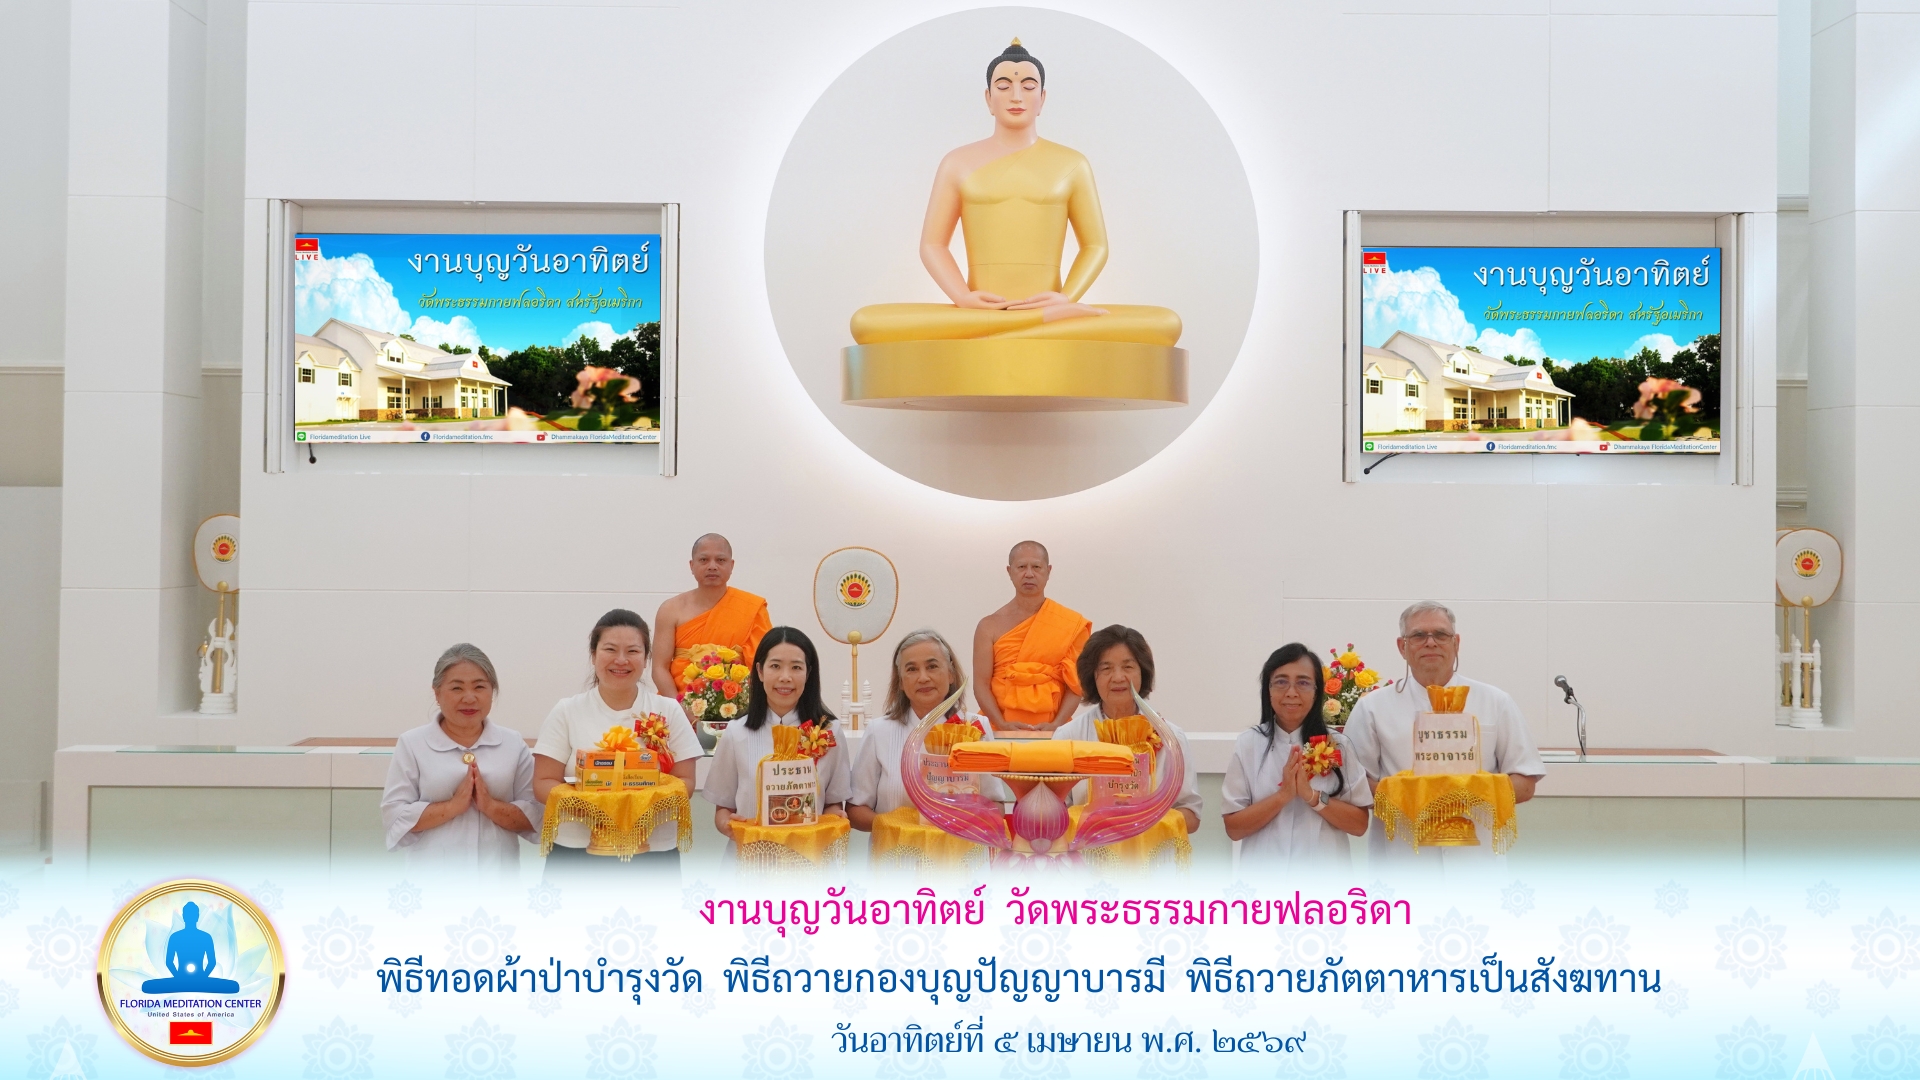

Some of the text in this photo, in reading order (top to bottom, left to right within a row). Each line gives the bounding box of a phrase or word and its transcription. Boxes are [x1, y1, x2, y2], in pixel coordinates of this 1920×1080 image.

[408, 241, 650, 282] งานบุญวันอาทิตย์
[1473, 255, 1711, 295] งานบุญวันอาทิตย์
[418, 287, 643, 313] วัดพระธรรมกายฟลอริดา สหรัฐอเมริกา
[1483, 300, 1704, 326] วัดพระธรรมกายฟลอริดา สหรัฐอเมริกา
[309, 433, 371, 441] Floridameditation Live
[551, 433, 588, 442] Dhammakaya
[1377, 443, 1438, 451] Floridameditation Live
[1613, 443, 1650, 452] Dhammakaya
[1417, 729, 1468, 744] บูชาธรรม
[1415, 746, 1475, 762] พระอาจารย์
[772, 763, 812, 776] ประธาน
[1108, 779, 1139, 792] บำรุงวัด
